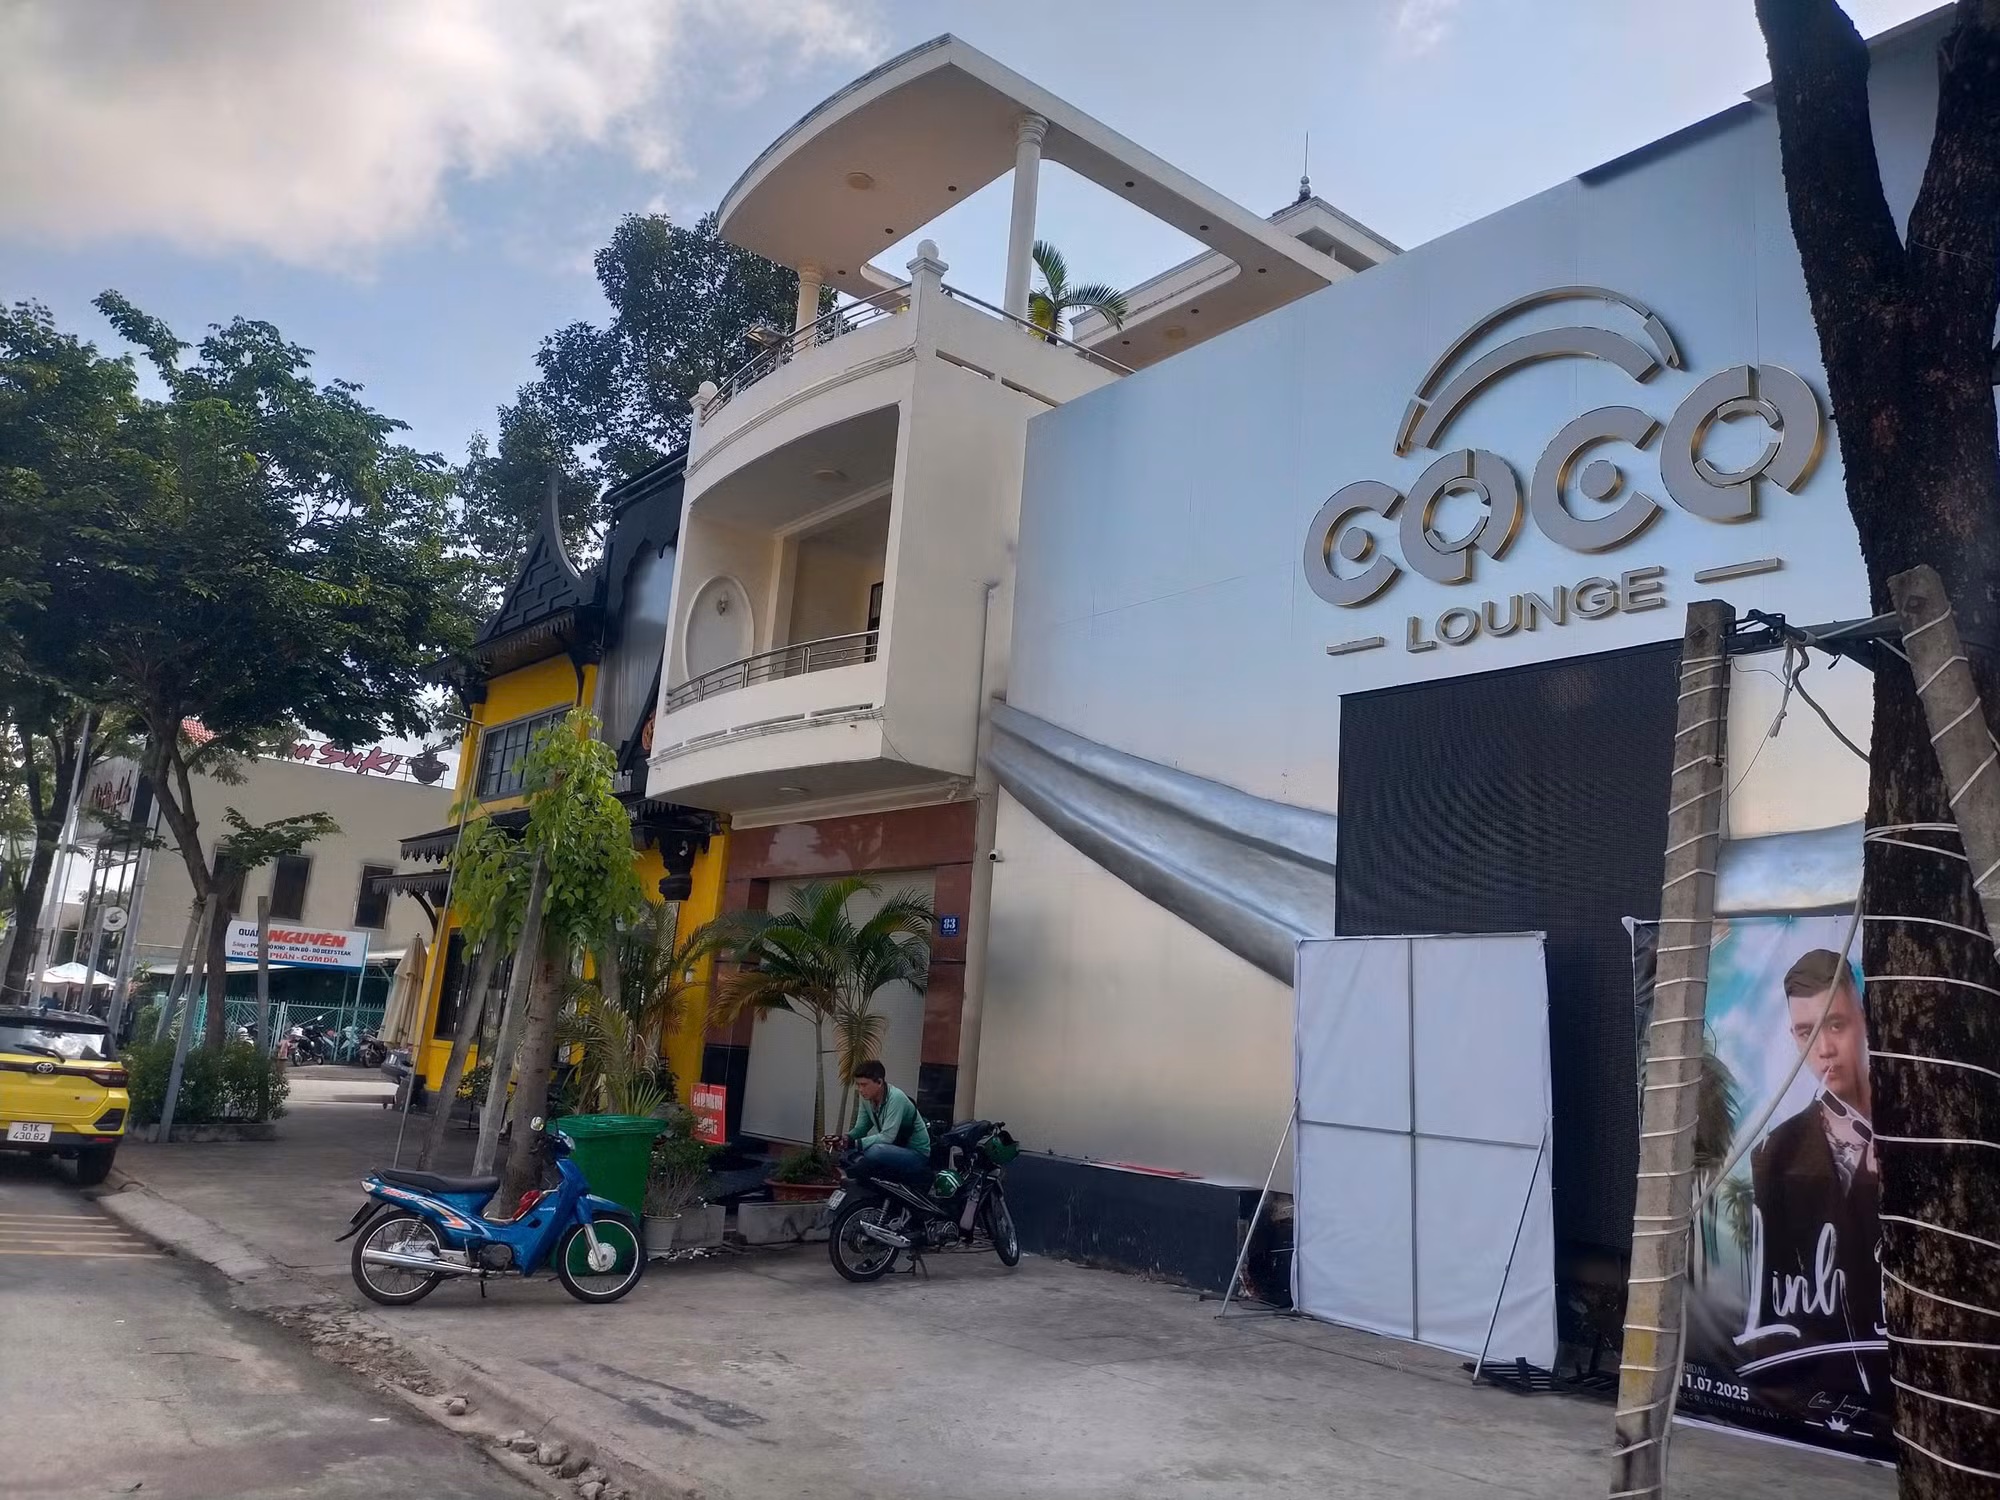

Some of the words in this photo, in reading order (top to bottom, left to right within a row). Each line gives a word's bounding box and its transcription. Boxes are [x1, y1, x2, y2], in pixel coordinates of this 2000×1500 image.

[1406, 566, 1666, 651] LOUNGE
[943, 918, 956, 929] 83
[22, 1124, 40, 1132] 61K
[13, 1131, 46, 1141] 430.82
[1682, 1361, 1707, 1376] RIDAY
